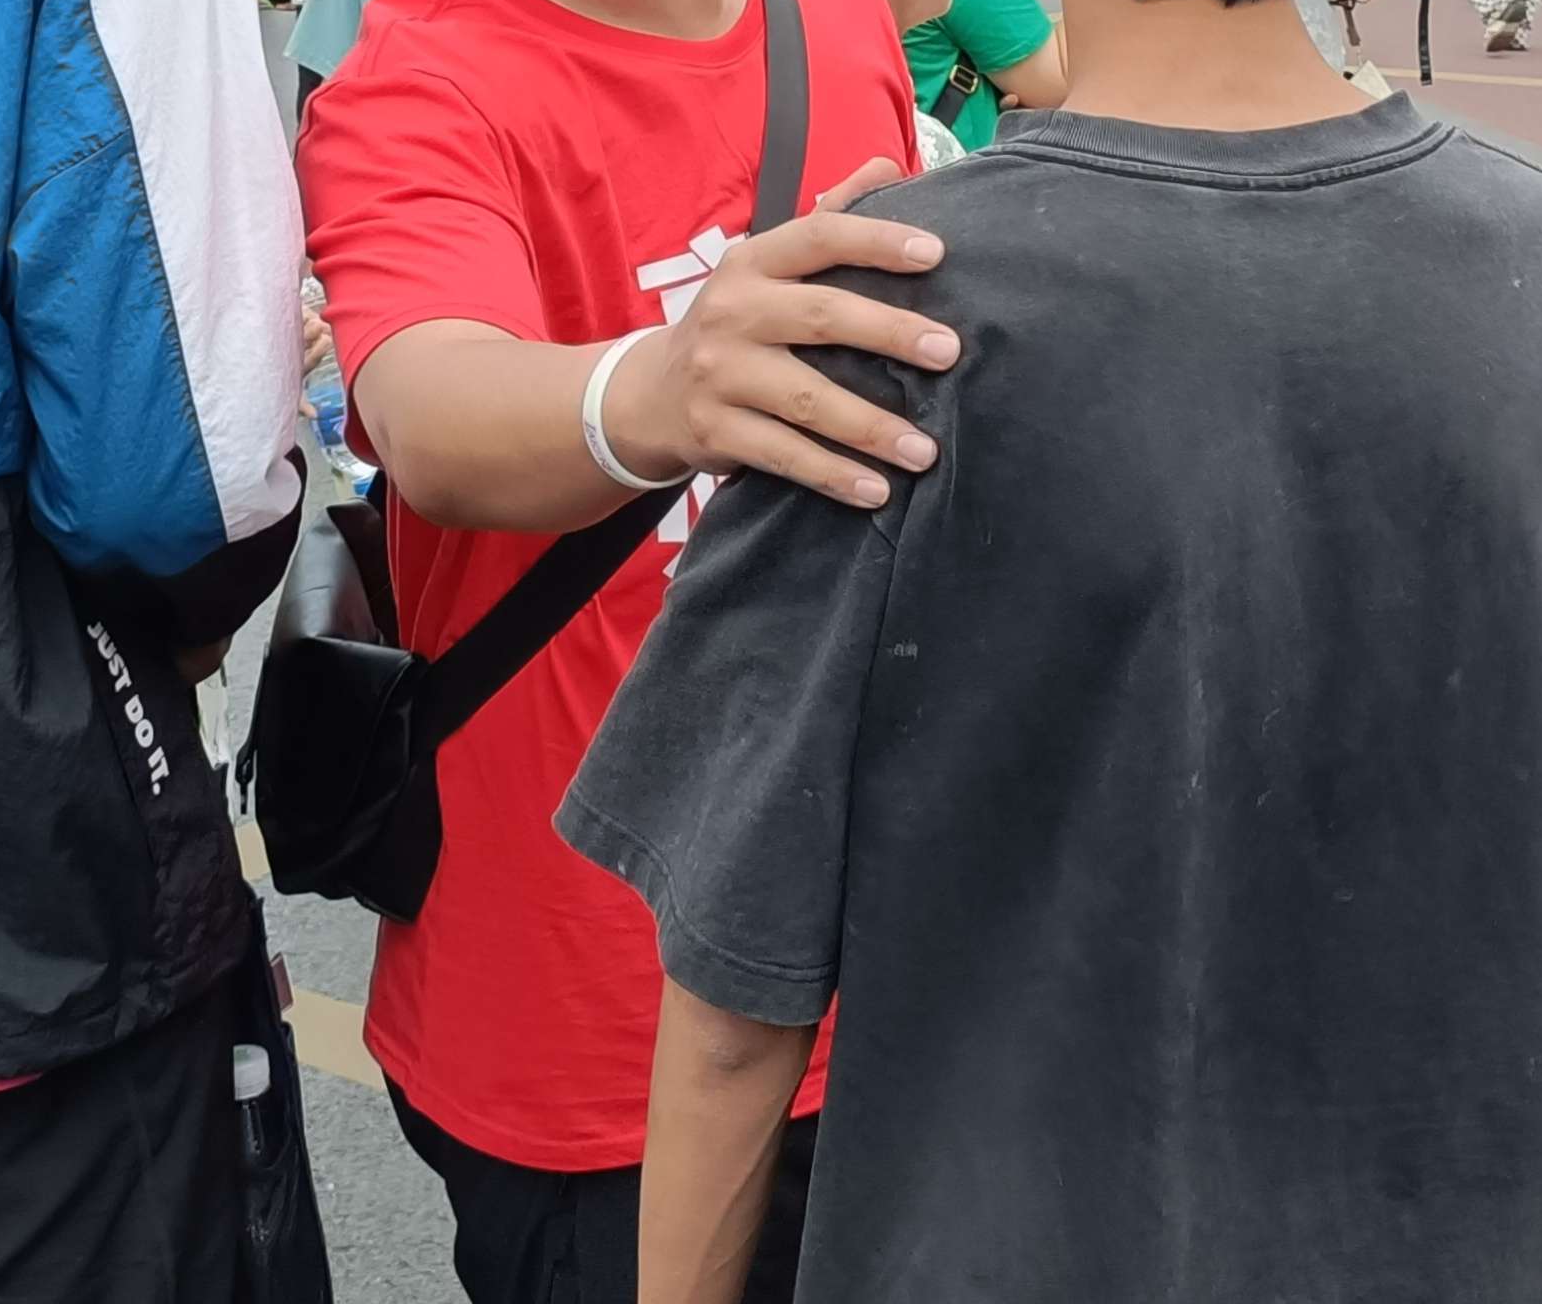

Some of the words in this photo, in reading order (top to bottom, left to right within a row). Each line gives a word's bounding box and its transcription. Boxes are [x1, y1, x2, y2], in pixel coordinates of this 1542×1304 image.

[87, 621, 132, 692] JUST
[125, 694, 154, 748] DO
[148, 746, 170, 795] IT.
